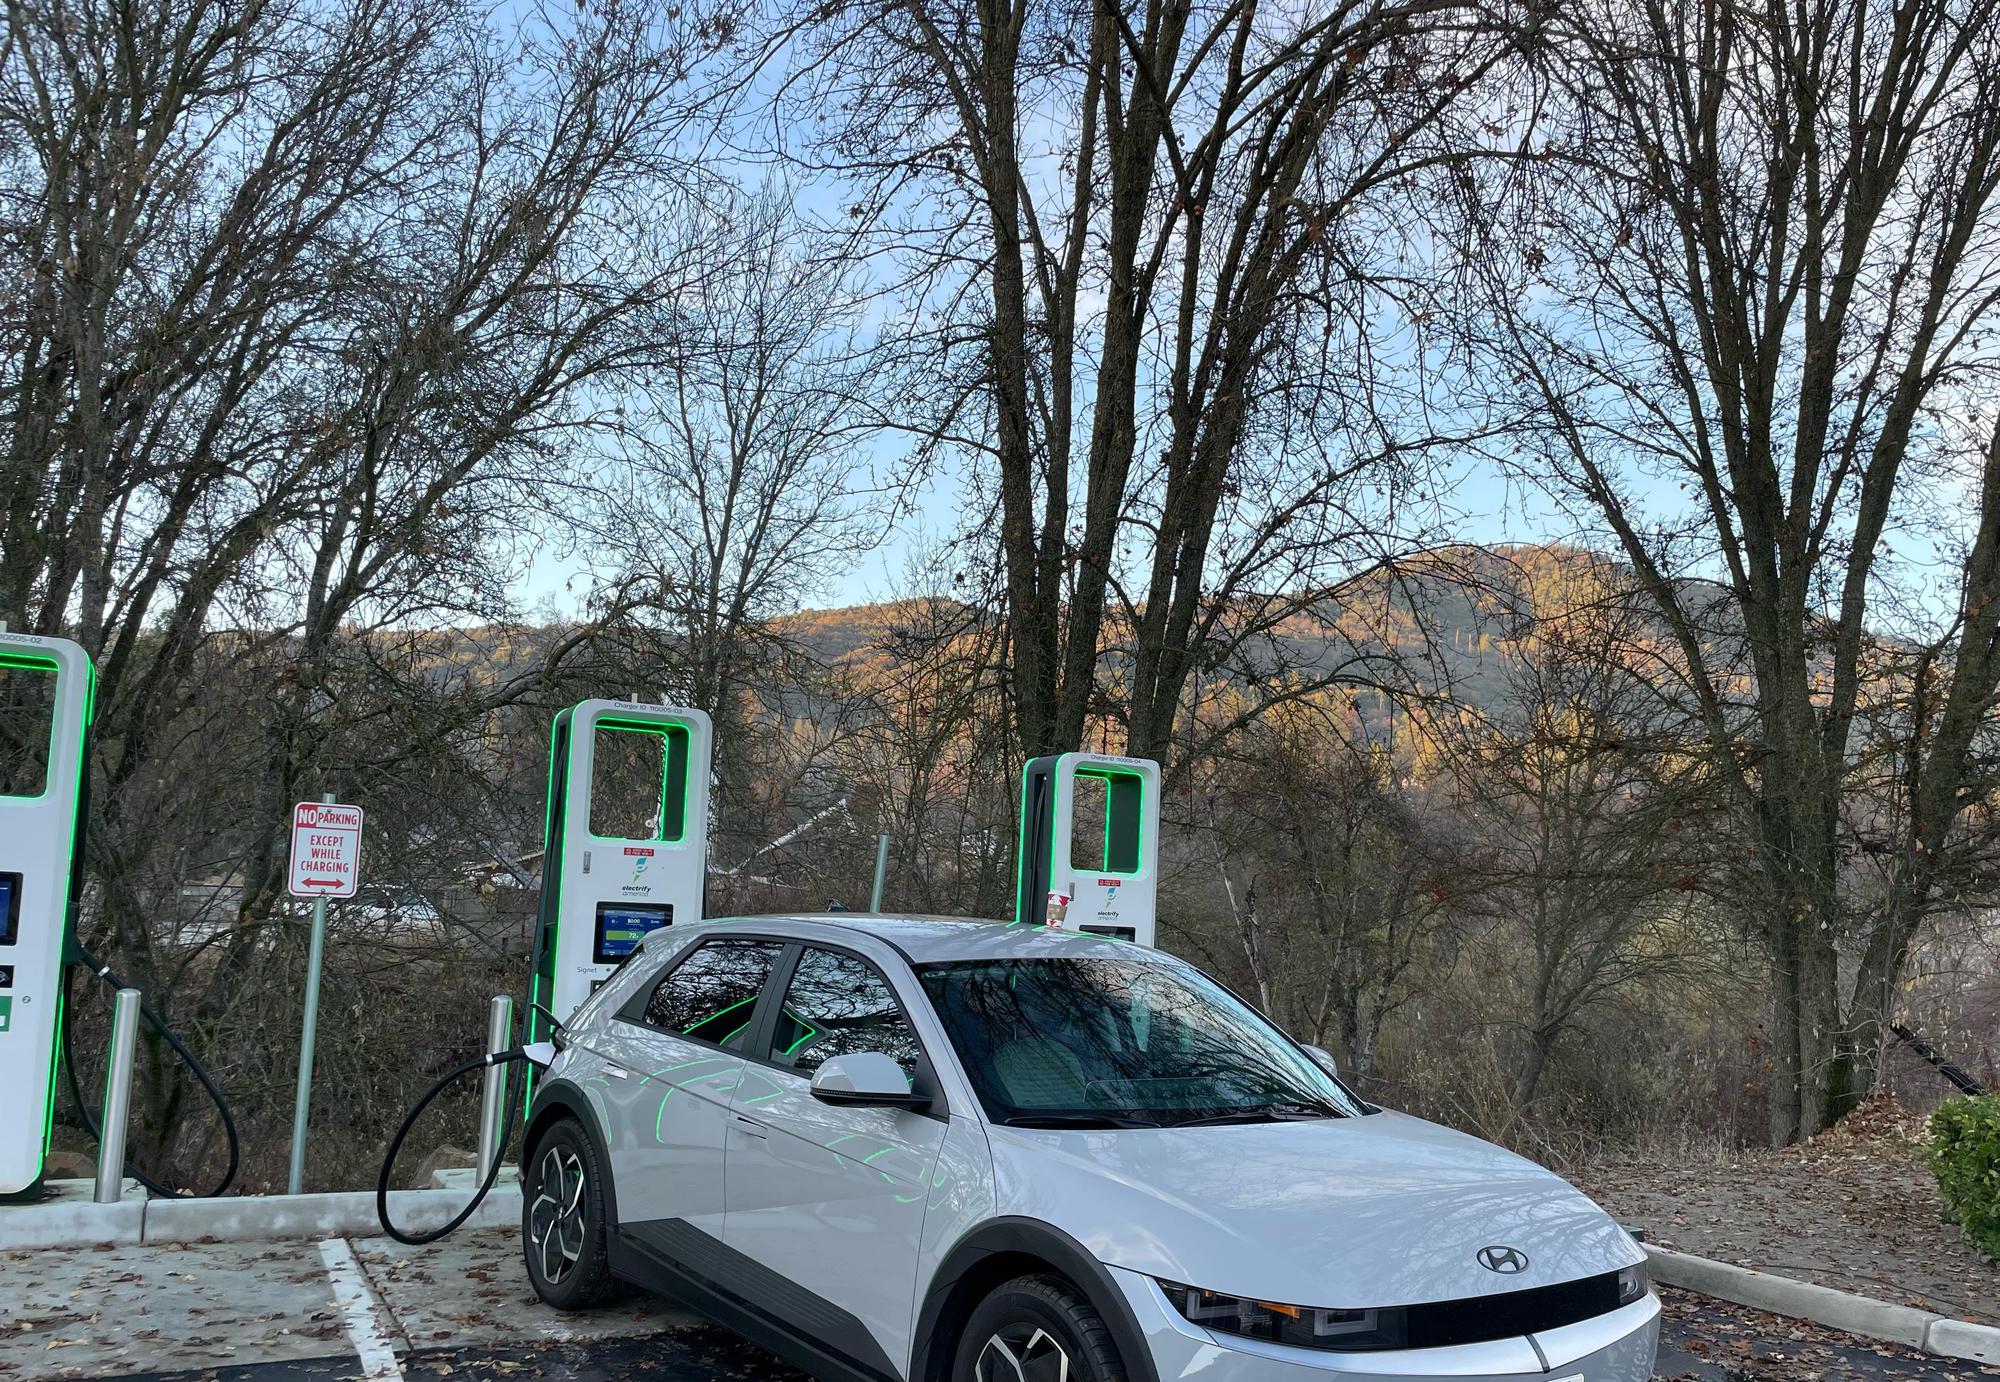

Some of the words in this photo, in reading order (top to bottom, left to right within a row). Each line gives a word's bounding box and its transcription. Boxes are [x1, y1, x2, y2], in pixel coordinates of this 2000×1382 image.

[614, 701, 638, 710] Charger
[298, 808, 317, 825] NO
[318, 812, 357, 825] PARKING
[310, 835, 344, 847] EXCEPT
[311, 848, 341, 860] WHILE
[300, 860, 349, 873] CHARGING
[622, 885, 651, 893] electrify
[576, 966, 598, 974] Signet
